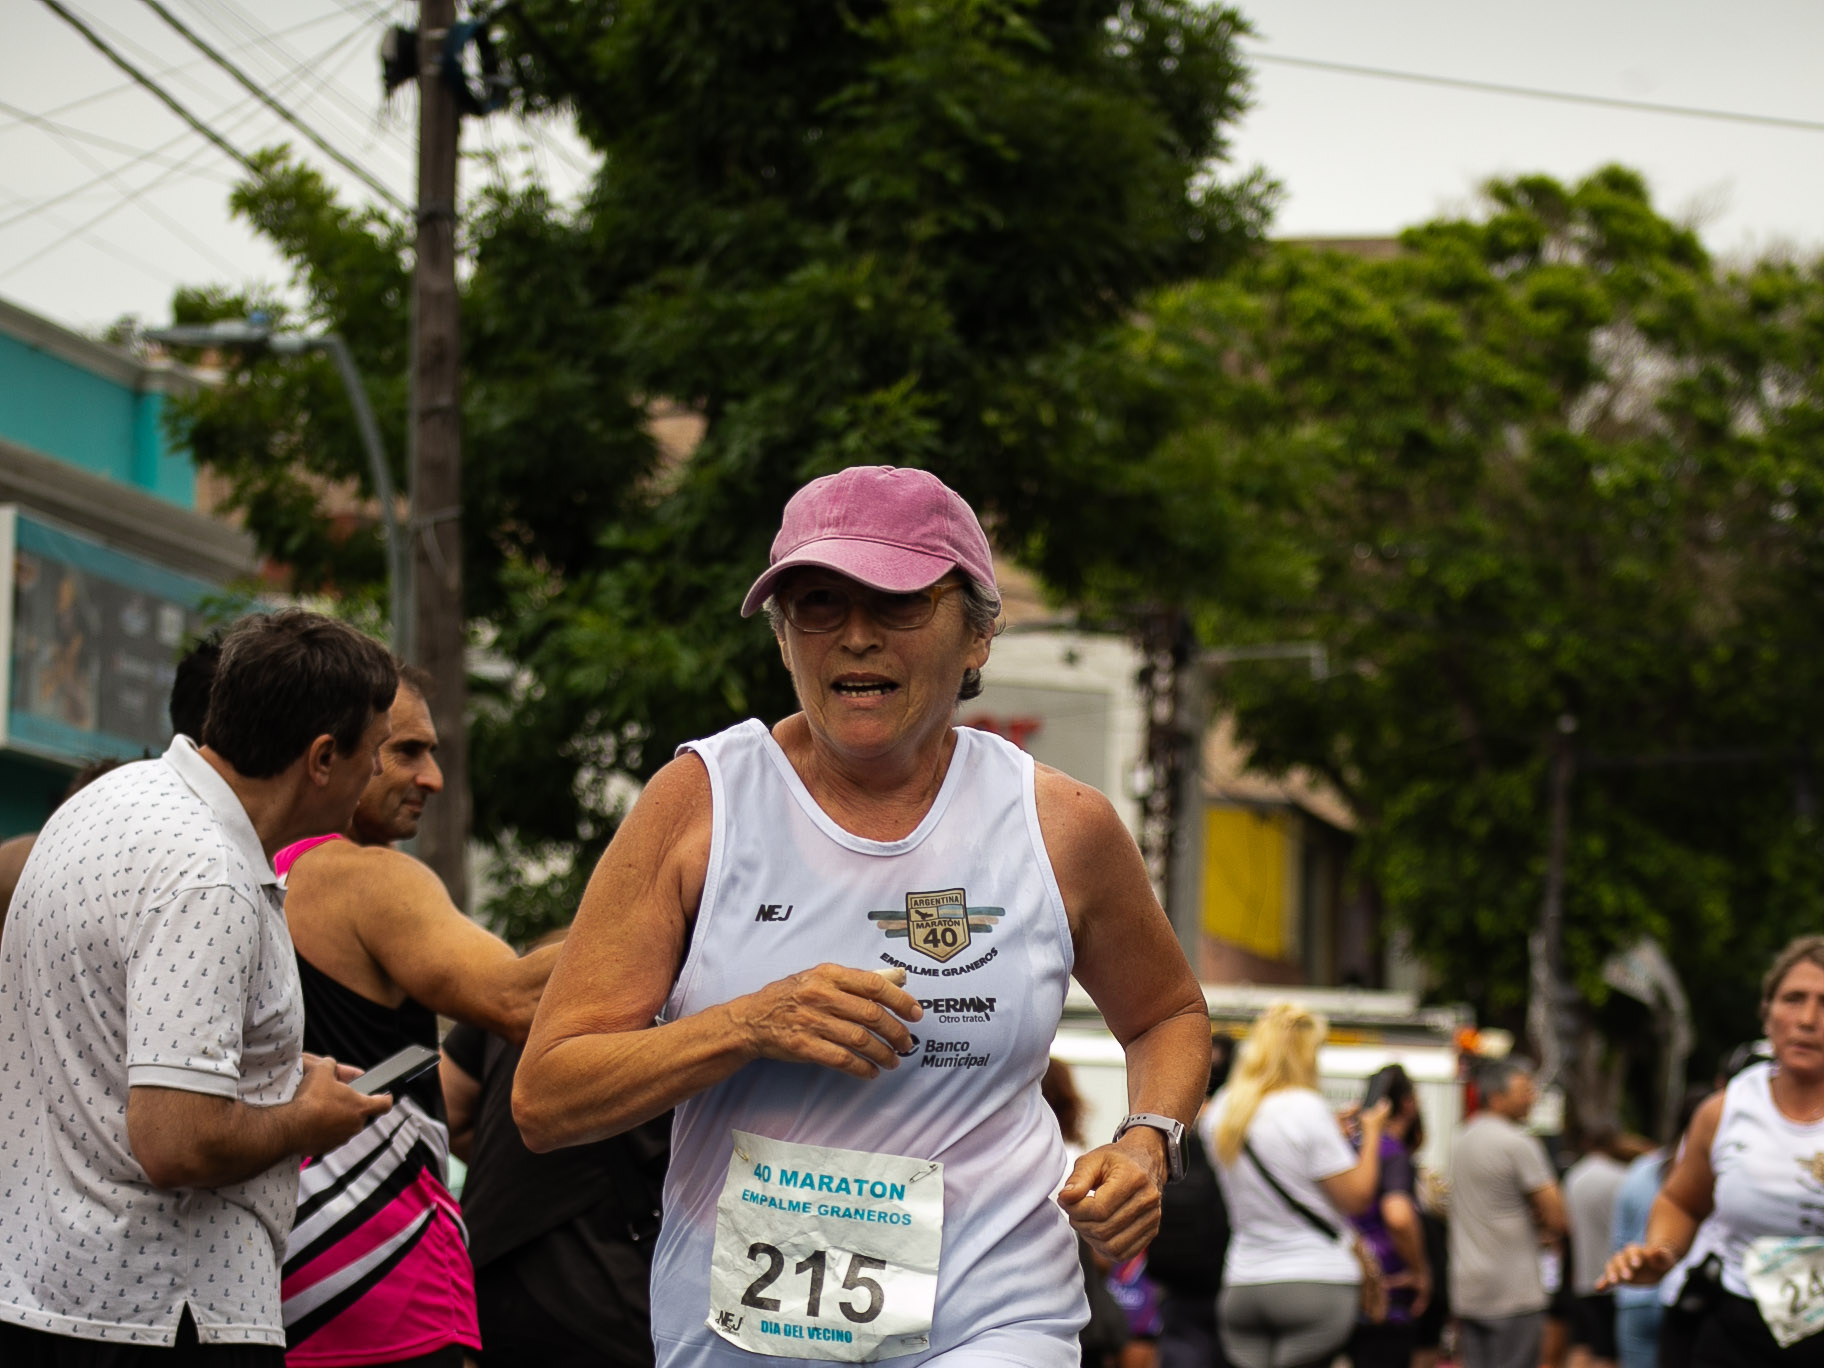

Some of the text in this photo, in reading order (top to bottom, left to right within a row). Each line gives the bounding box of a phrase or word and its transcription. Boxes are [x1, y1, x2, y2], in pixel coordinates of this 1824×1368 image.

[913, 895, 960, 907] ARGENTINA
[755, 904, 793, 922] NEJ
[916, 917, 961, 929] MARATÓN
[923, 927, 958, 948] 40
[879, 947, 999, 977] EMPALME GRANEROS
[917, 997, 996, 1013] PERMAT
[939, 1015, 985, 1023] Otro trato.
[925, 1039, 970, 1053] Banco
[920, 1054, 990, 1069] Municipal
[753, 1162, 906, 1202] 40 MARATON
[741, 1188, 912, 1226] EMPALME GRANEROS
[740, 1241, 887, 1324] 215
[760, 1320, 781, 1336] DIA
[784, 1323, 805, 1340] DEL
[807, 1327, 853, 1344] VECINO
